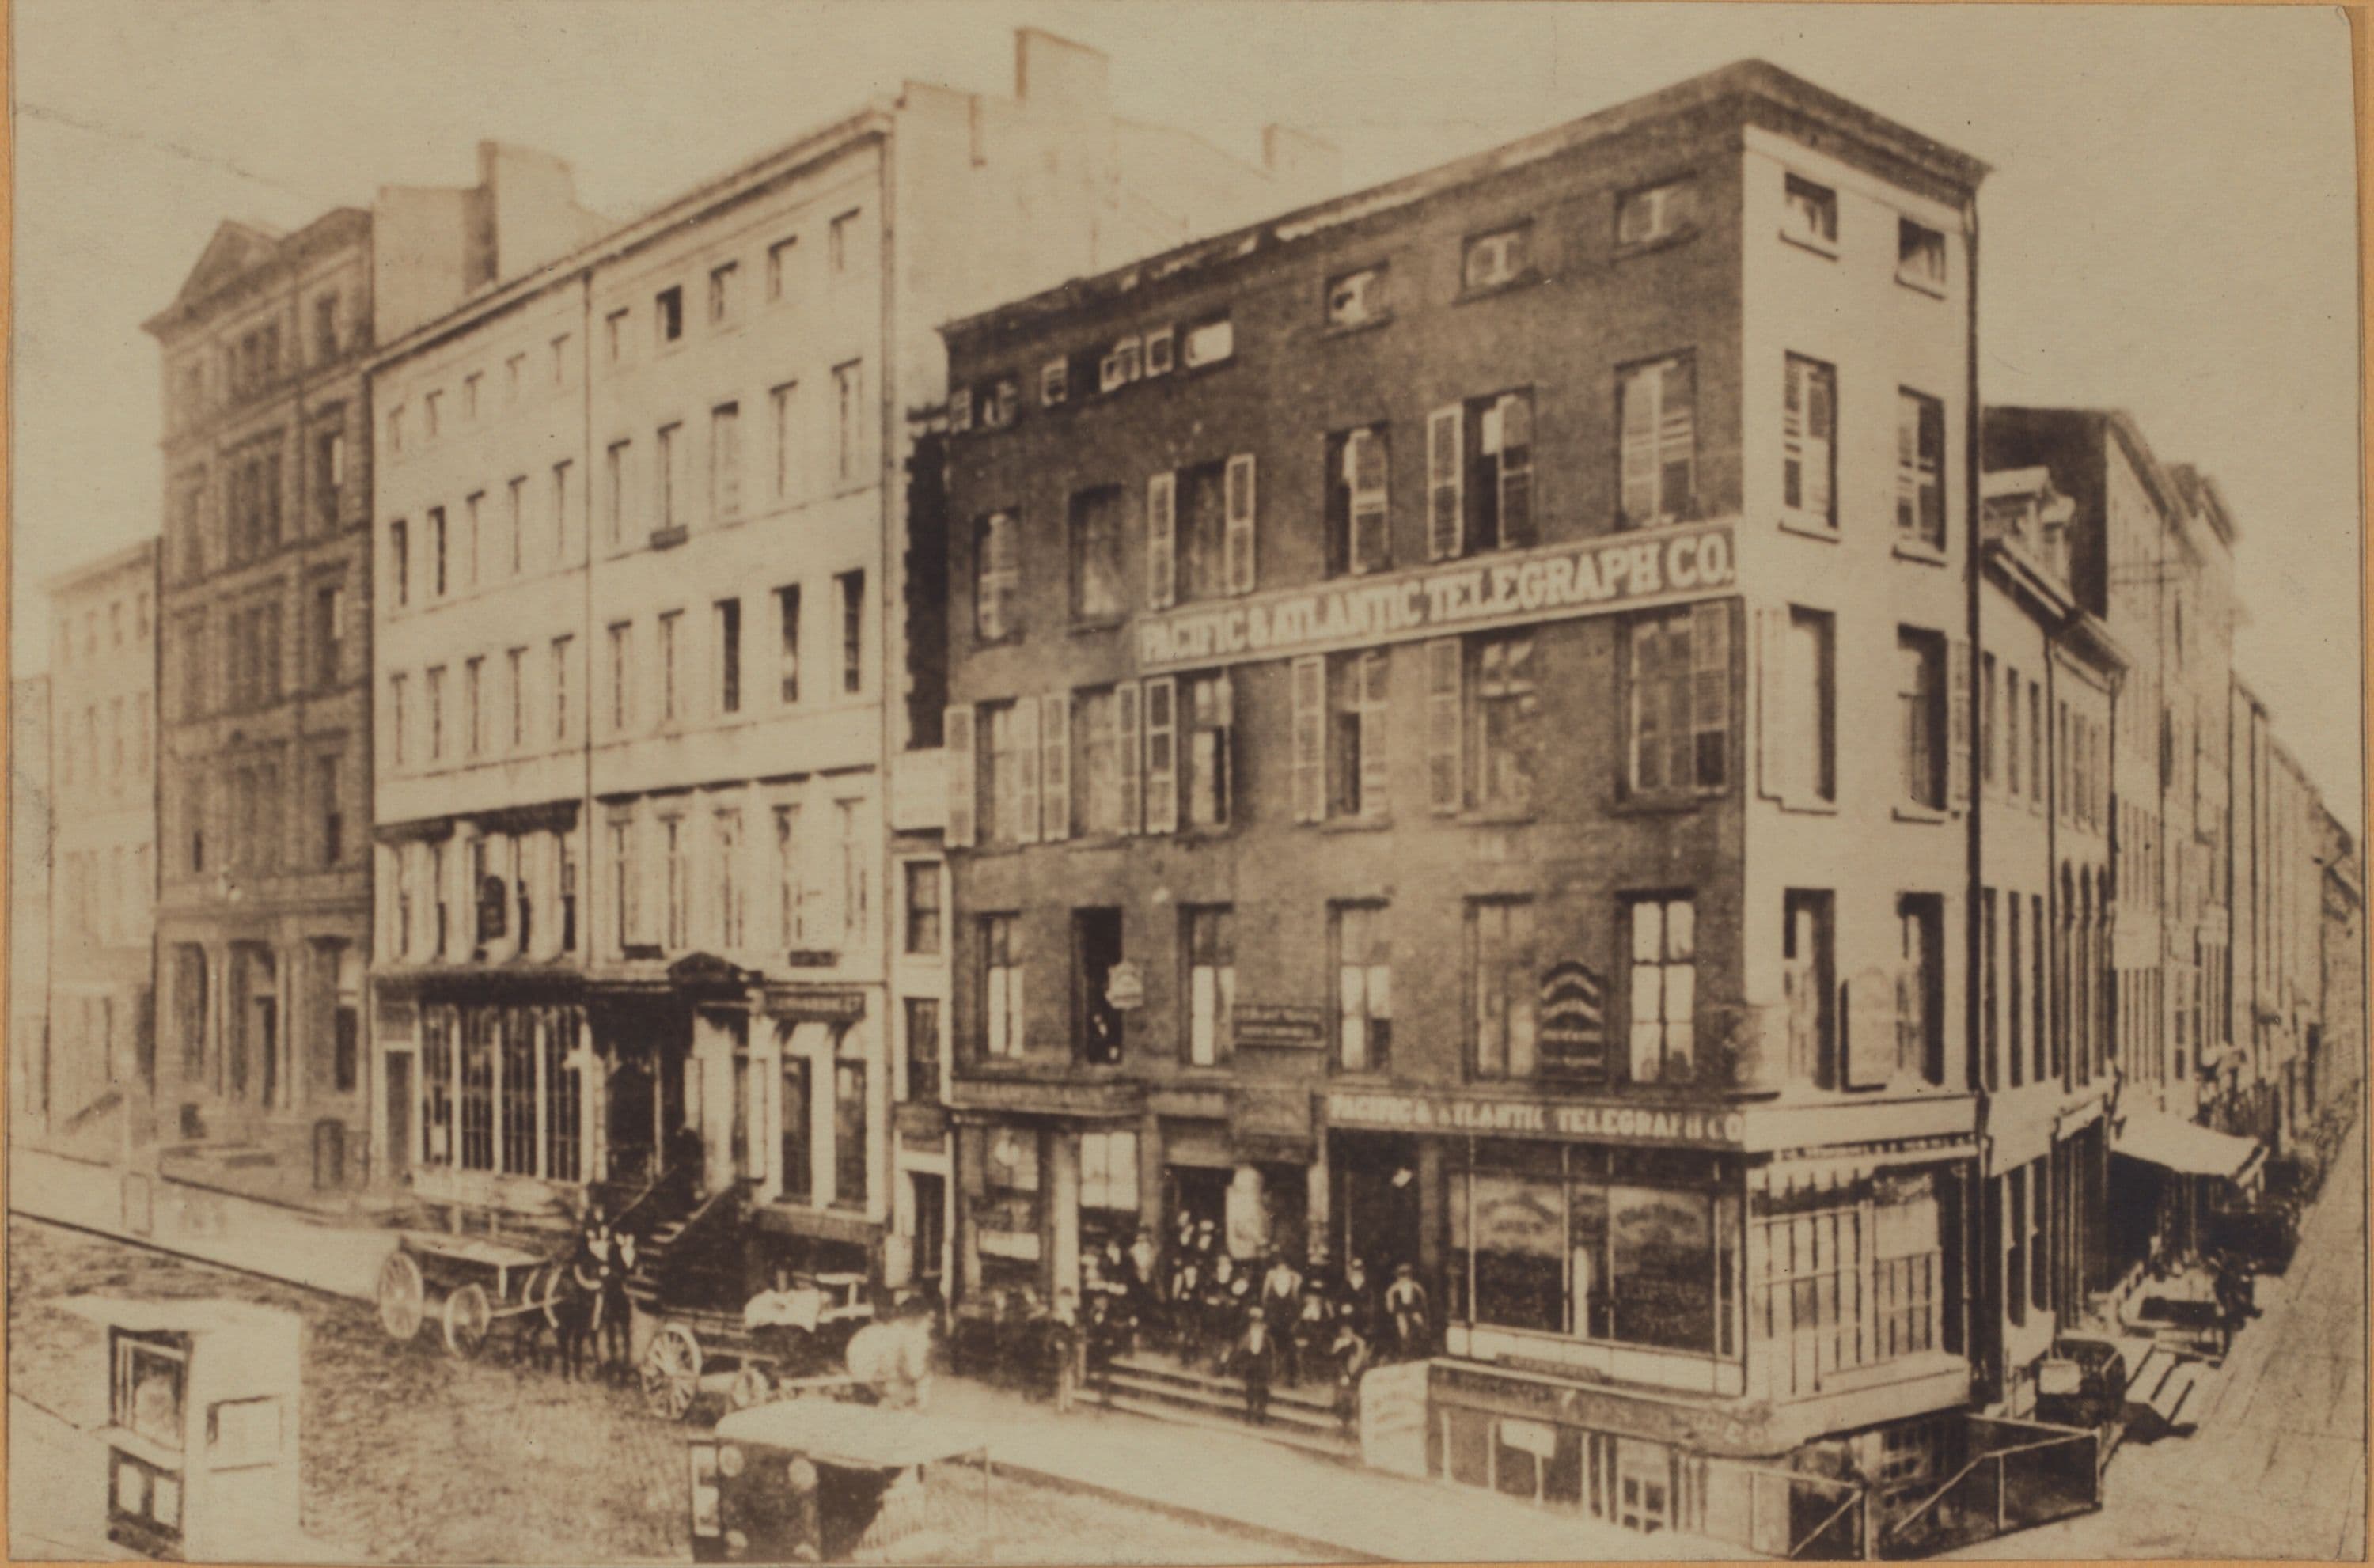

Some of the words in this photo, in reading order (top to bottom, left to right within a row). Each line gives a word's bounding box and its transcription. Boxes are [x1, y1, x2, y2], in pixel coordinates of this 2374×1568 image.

[1140, 610, 1245, 663] PACIFIC
[1246, 607, 1269, 649] &
[1271, 581, 1424, 646] ATLANTIC
[1424, 543, 1661, 623] TELEGRAPH
[1665, 532, 1735, 589] CO.
